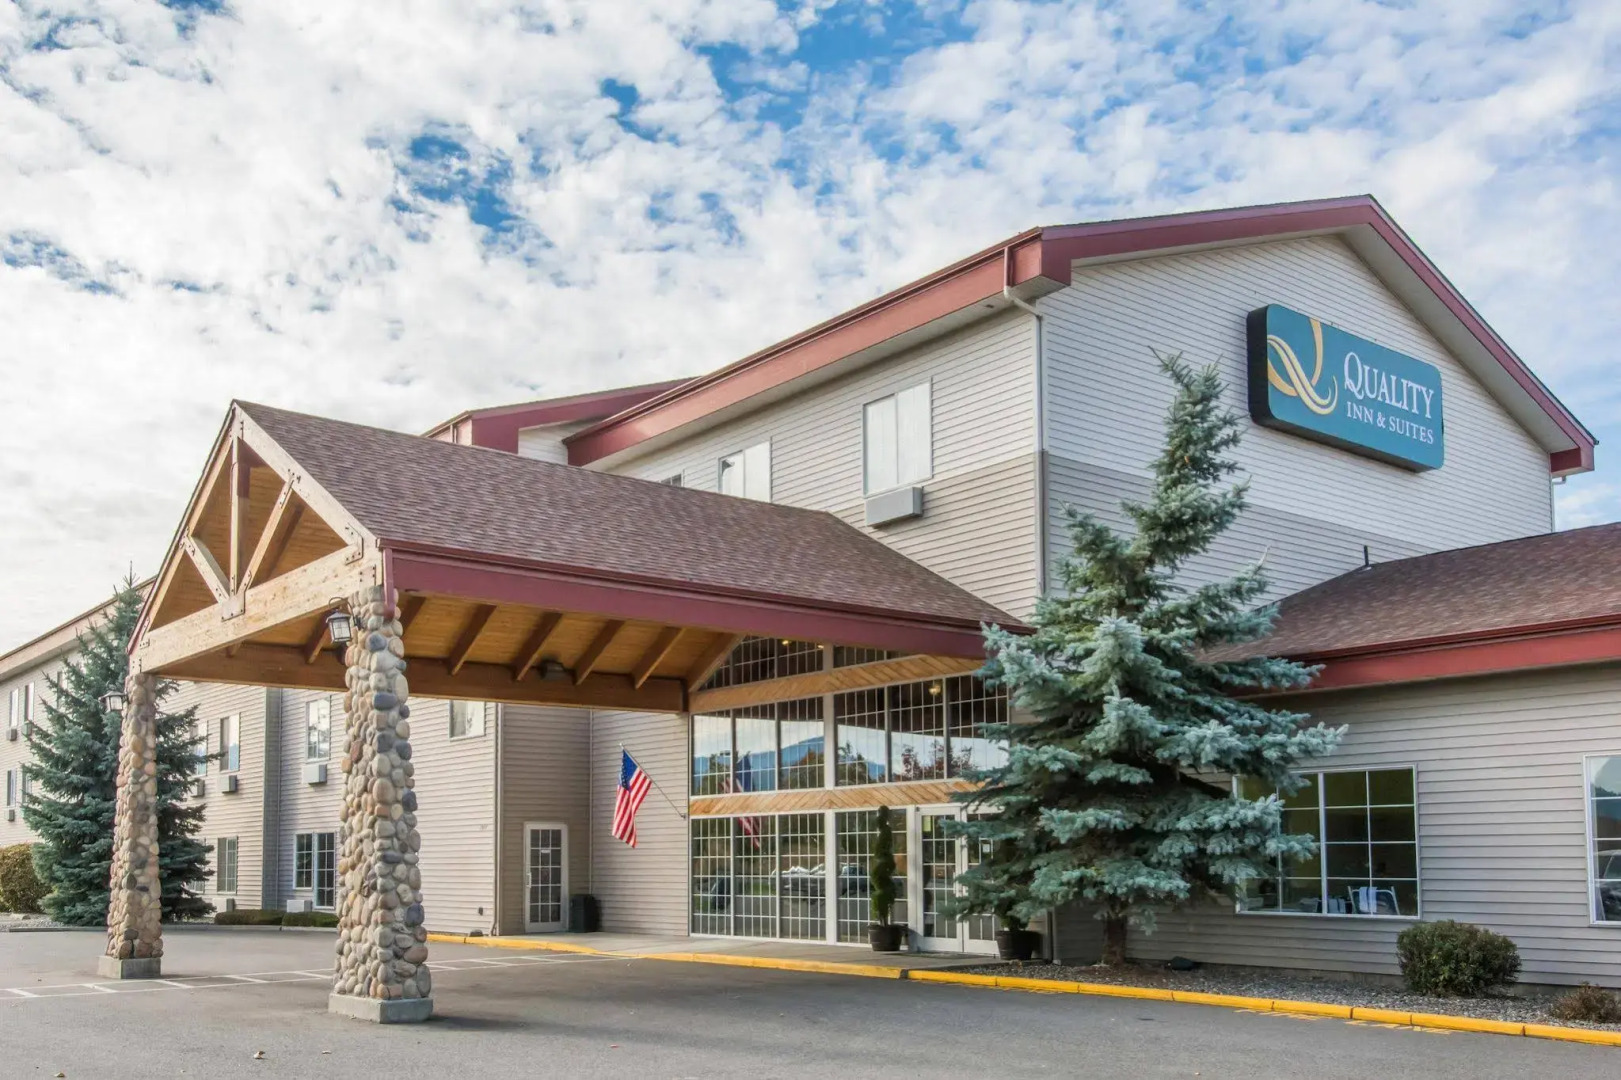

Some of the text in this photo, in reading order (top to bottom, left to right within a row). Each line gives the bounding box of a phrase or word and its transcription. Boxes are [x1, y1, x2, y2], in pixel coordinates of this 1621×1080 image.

[1344, 352, 1434, 419] QUALITY
[1347, 401, 1434, 445] INN & SUITES
